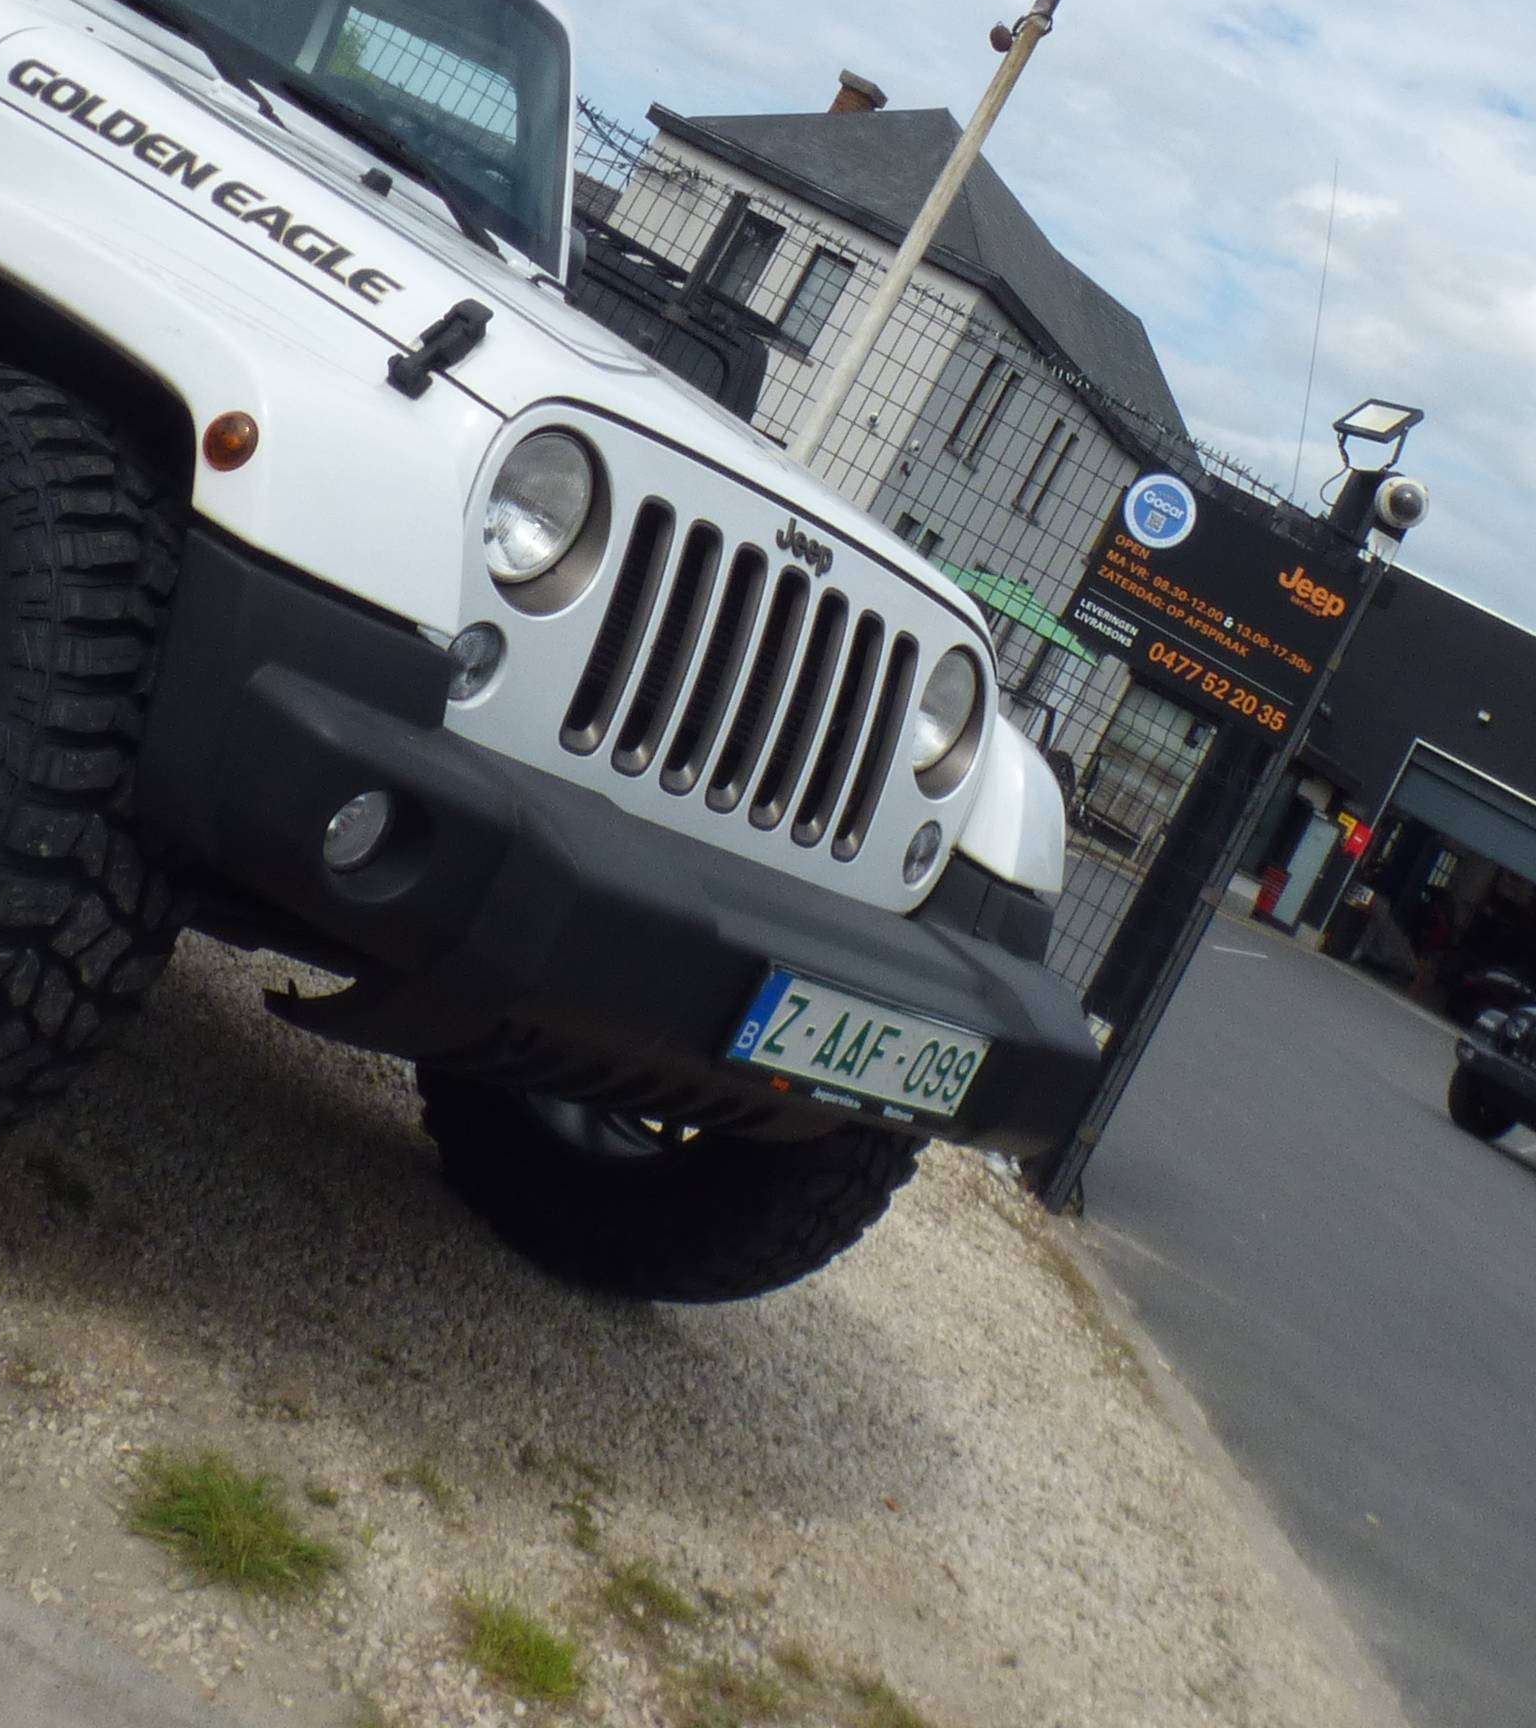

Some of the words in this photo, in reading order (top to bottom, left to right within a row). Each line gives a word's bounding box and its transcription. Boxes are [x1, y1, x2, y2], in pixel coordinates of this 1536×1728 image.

[7, 58, 223, 191] GOLDEN
[210, 180, 407, 306] EAGLE
[1144, 490, 1185, 521] Gocar
[775, 517, 834, 578] Jeep
[1115, 534, 1151, 561] OPEN
[1278, 565, 1346, 618] Jeep
[1073, 608, 1134, 648] LIVRAISONS
[1080, 597, 1140, 637] LEVERINGEN
[1166, 604, 1185, 619] OP
[1184, 615, 1250, 659] AFSPRAAK
[1148, 641, 1204, 681] 0477
[1200, 671, 1231, 701] 52
[1227, 688, 1259, 716] 20
[1256, 704, 1287, 732] 35
[736, 1020, 760, 1050] B
